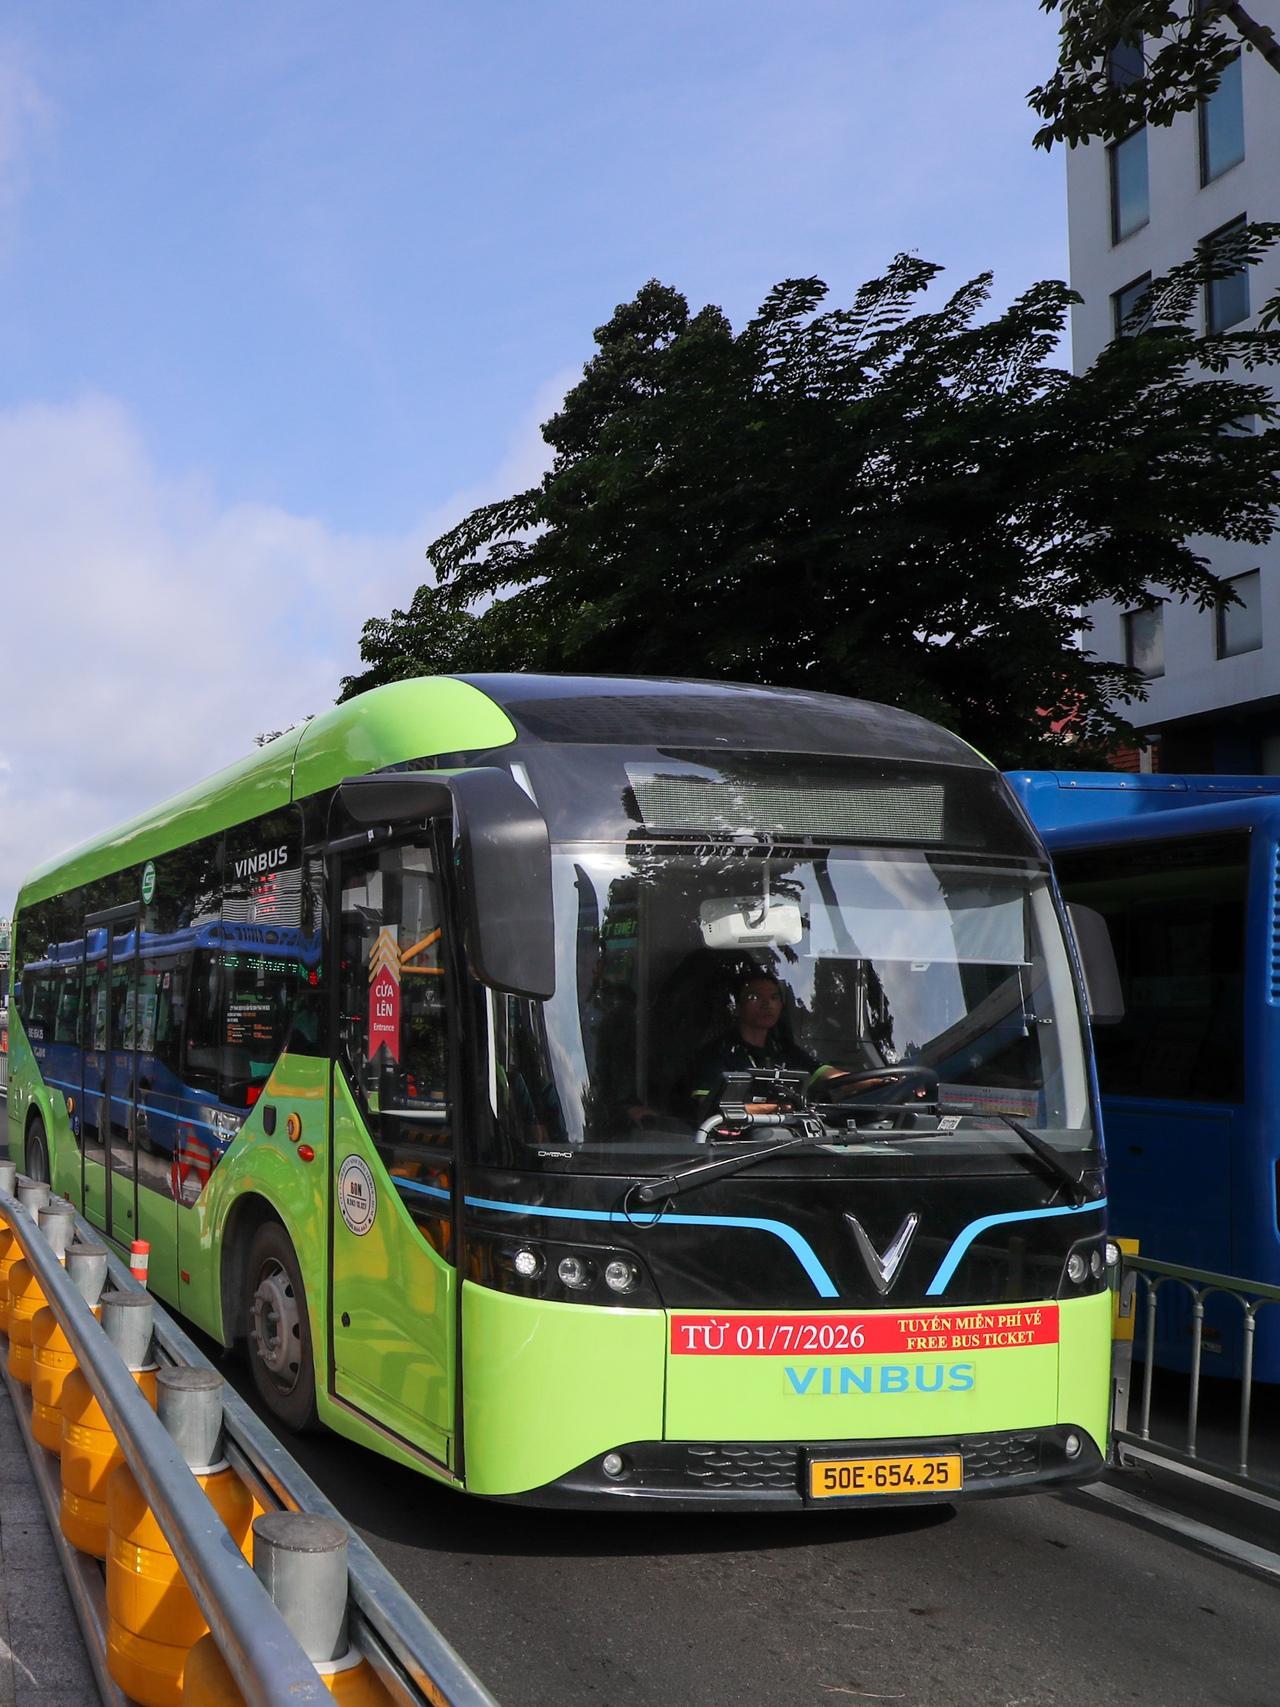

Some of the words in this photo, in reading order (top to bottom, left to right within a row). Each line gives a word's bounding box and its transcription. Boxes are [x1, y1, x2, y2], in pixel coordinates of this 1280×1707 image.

[235, 845, 288, 878] VINBUS
[375, 980, 394, 997] CỬA
[376, 1000, 393, 1017] LÊN
[373, 1023, 395, 1032] Entrance
[998, 1310, 1023, 1328] PHÍ
[1024, 1310, 1042, 1326] VÉ
[681, 1319, 730, 1350] TỪ
[736, 1324, 866, 1351] 01/7/2026
[906, 1335, 948, 1350] FREE
[951, 1333, 981, 1348] BUS
[982, 1330, 1035, 1346] TICKET
[784, 1364, 974, 1395] VINBUS
[823, 1462, 949, 1491] 50E-654.25
